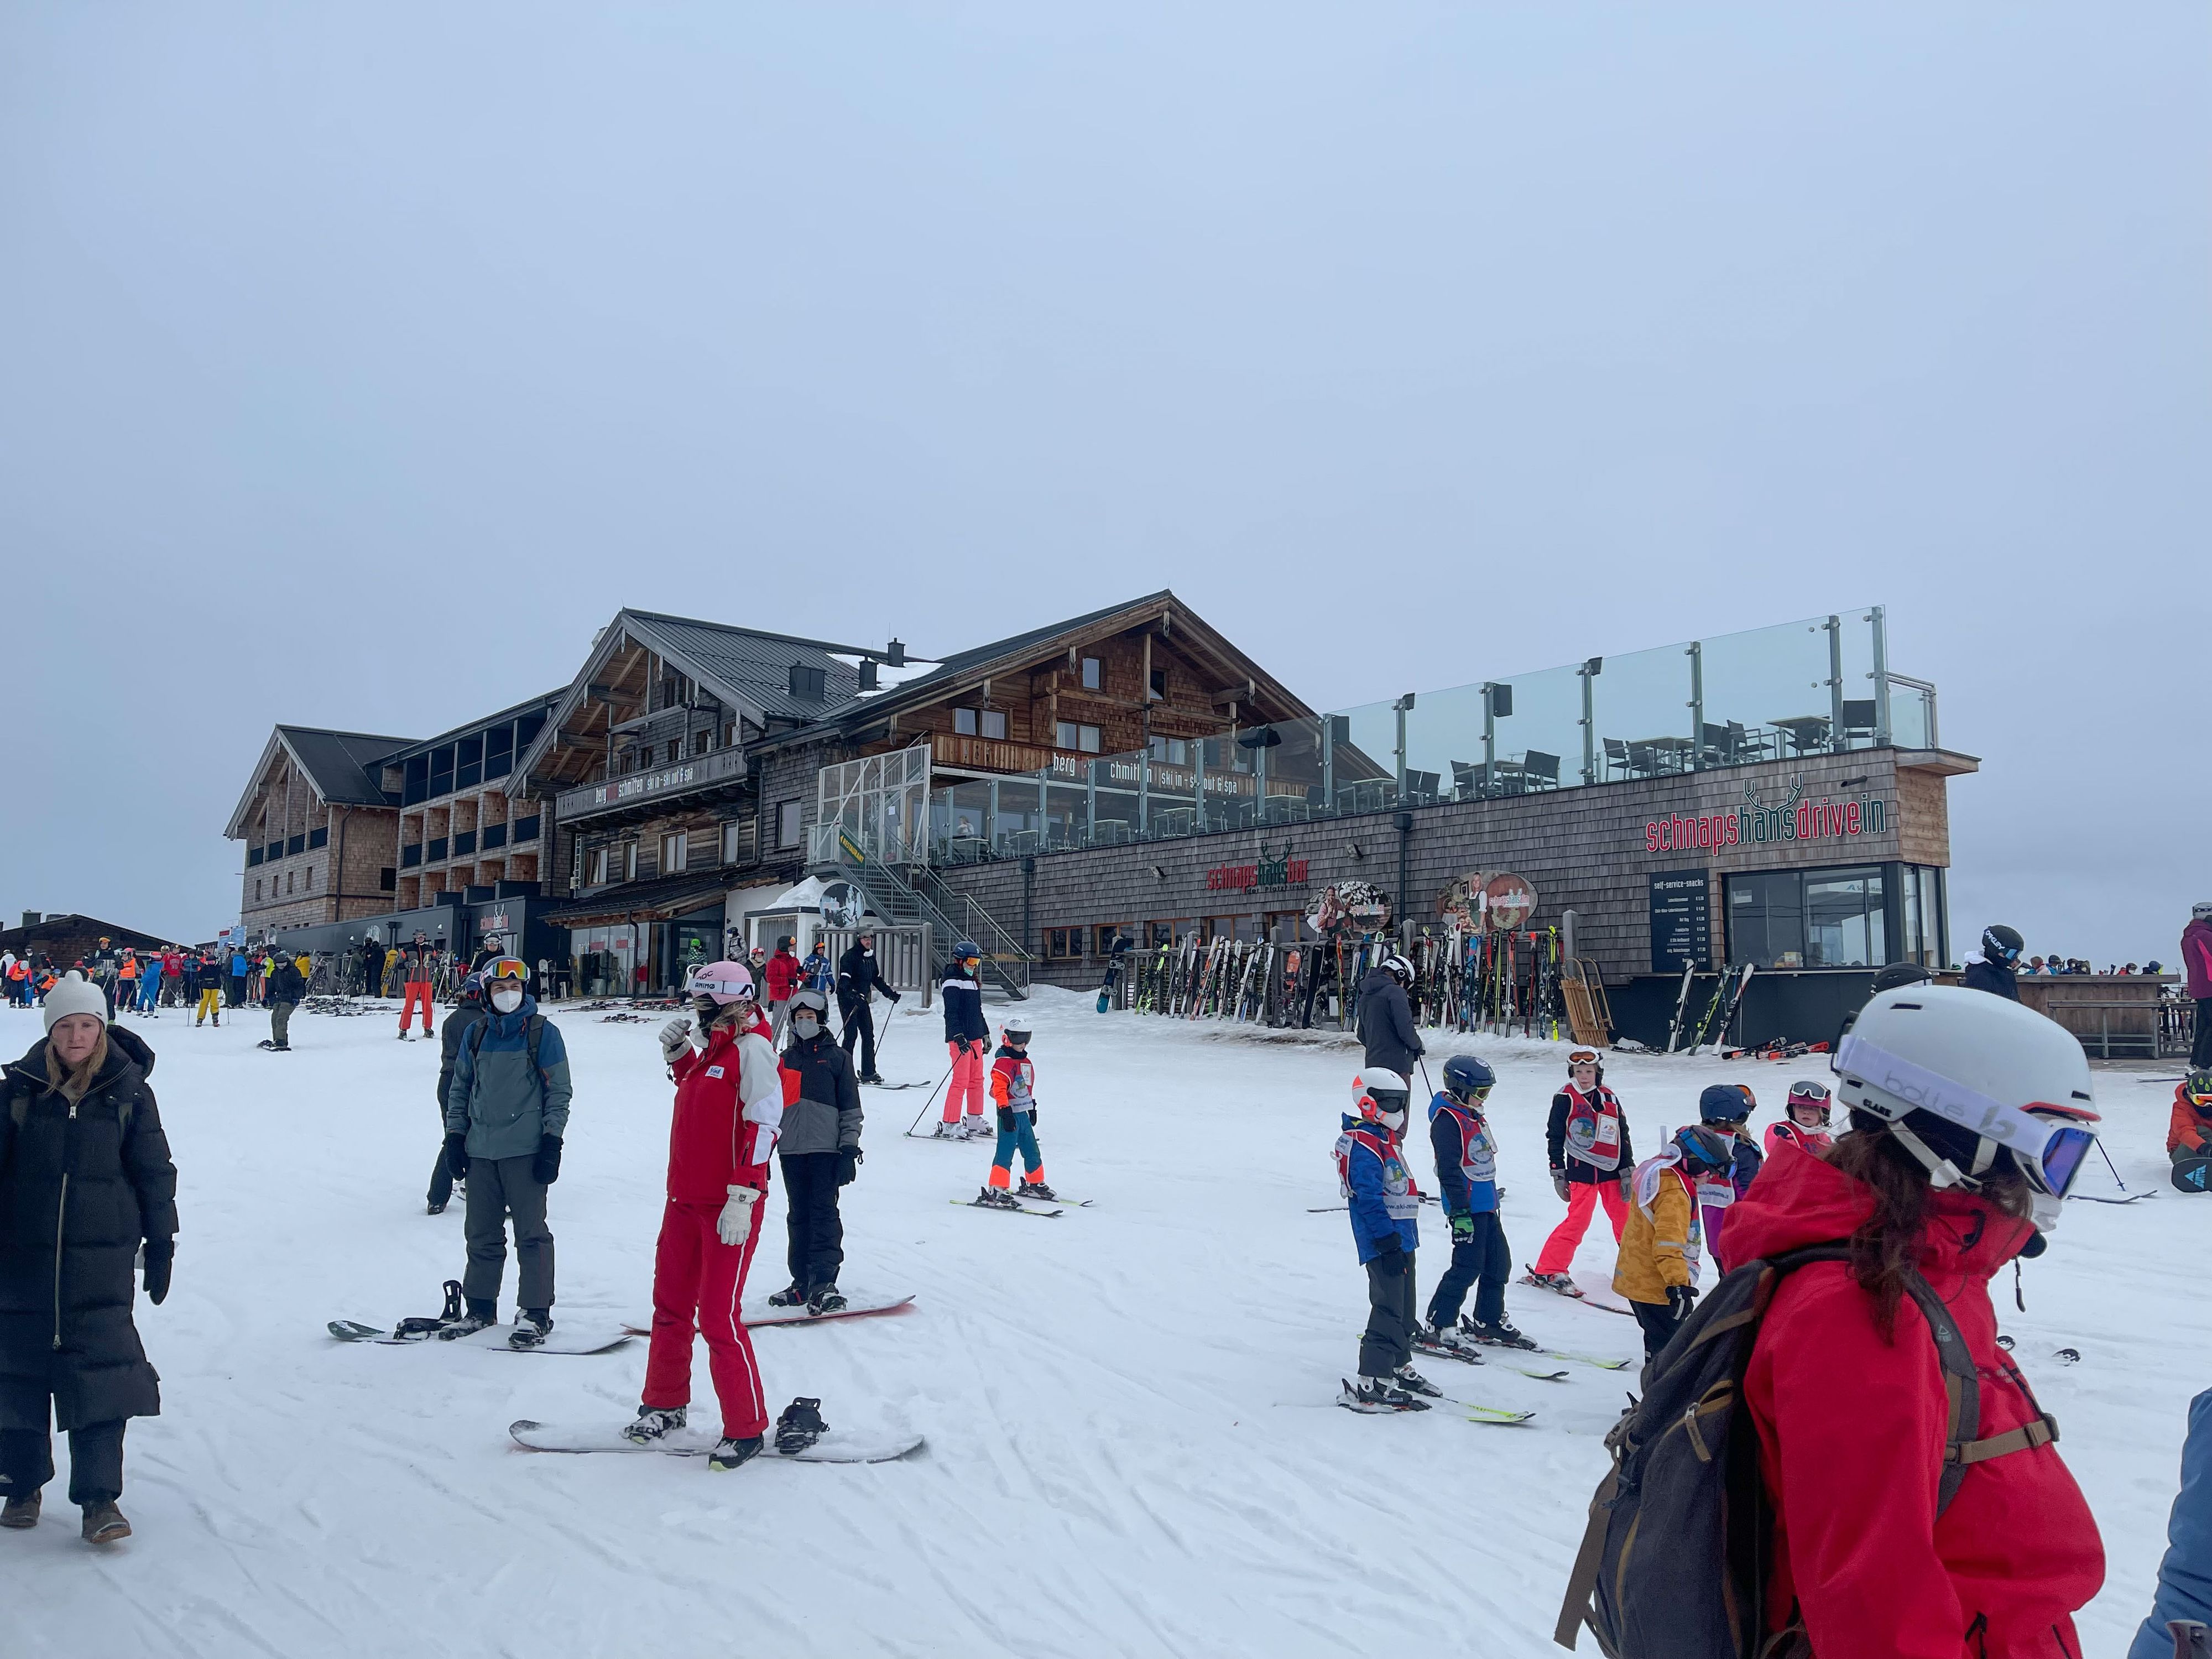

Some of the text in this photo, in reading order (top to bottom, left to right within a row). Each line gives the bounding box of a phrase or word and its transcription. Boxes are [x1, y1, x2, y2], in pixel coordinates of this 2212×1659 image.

[596, 787, 607, 805] berg
[619, 777, 643, 797] schmitten
[655, 774, 660, 789] in
[680, 768, 684, 782] &
[684, 767, 693, 784] spa
[1053, 753, 1076, 777] berg
[1110, 760, 1152, 783] chmittn
[1161, 771, 1173, 785] ski
[1175, 772, 1182, 787] in
[1203, 776, 1215, 791] out
[1217, 776, 1222, 791] &
[1224, 778, 1237, 796] spa
[842, 837, 864, 864] RESTAURANT
[1207, 855, 1309, 894] schnapshansbar
[1654, 879, 1704, 890] self-service-snacks
[1985, 930, 2005, 950] OAKLEY
